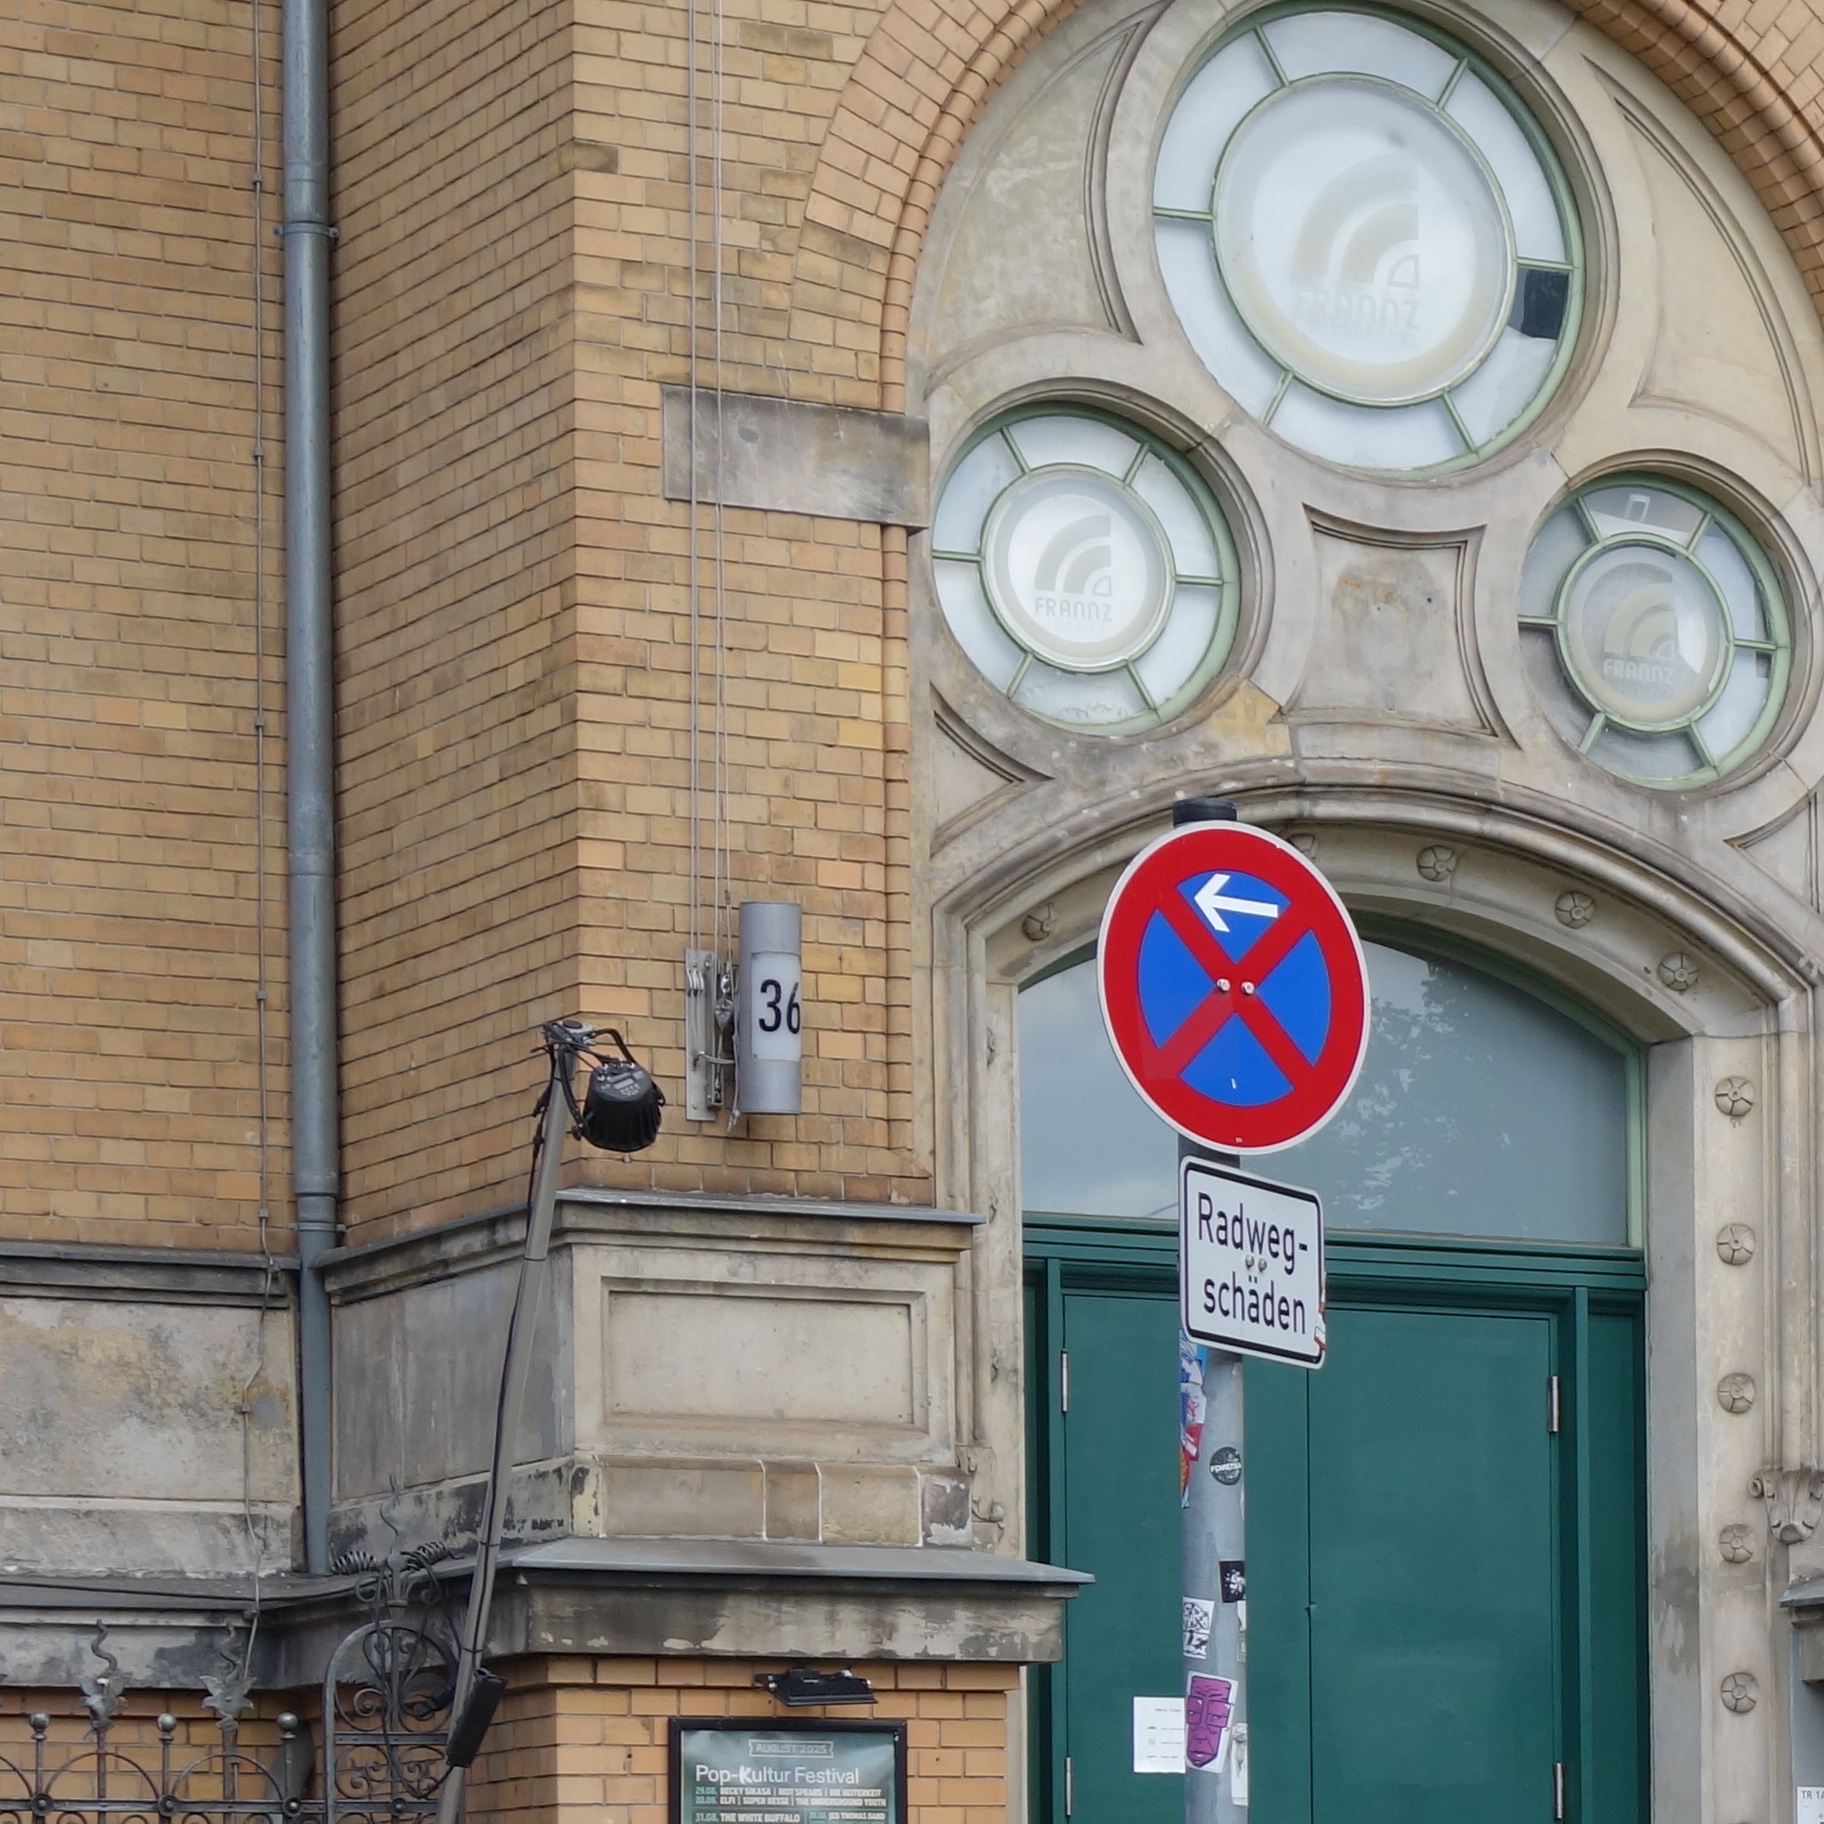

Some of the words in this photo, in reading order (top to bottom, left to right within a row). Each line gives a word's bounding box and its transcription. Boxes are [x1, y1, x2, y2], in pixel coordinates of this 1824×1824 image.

[1035, 597, 1113, 622] FRANNZ
[1604, 659, 1674, 684] FRANNZ
[758, 979, 800, 1034] 36
[1197, 1192, 1309, 1276] Radweg-
[1202, 1273, 1307, 1335] schäden
[755, 1742, 798, 1754] AUGUST
[800, 1743, 828, 1755] 2025
[695, 1764, 790, 1788] Pop-Kultur
[794, 1766, 859, 1784] Festival
[1801, 1790, 1812, 1799] TR
[720, 1813, 736, 1823] THE
[738, 1813, 763, 1823] WHITE
[764, 1813, 800, 1823] BUFFALO
